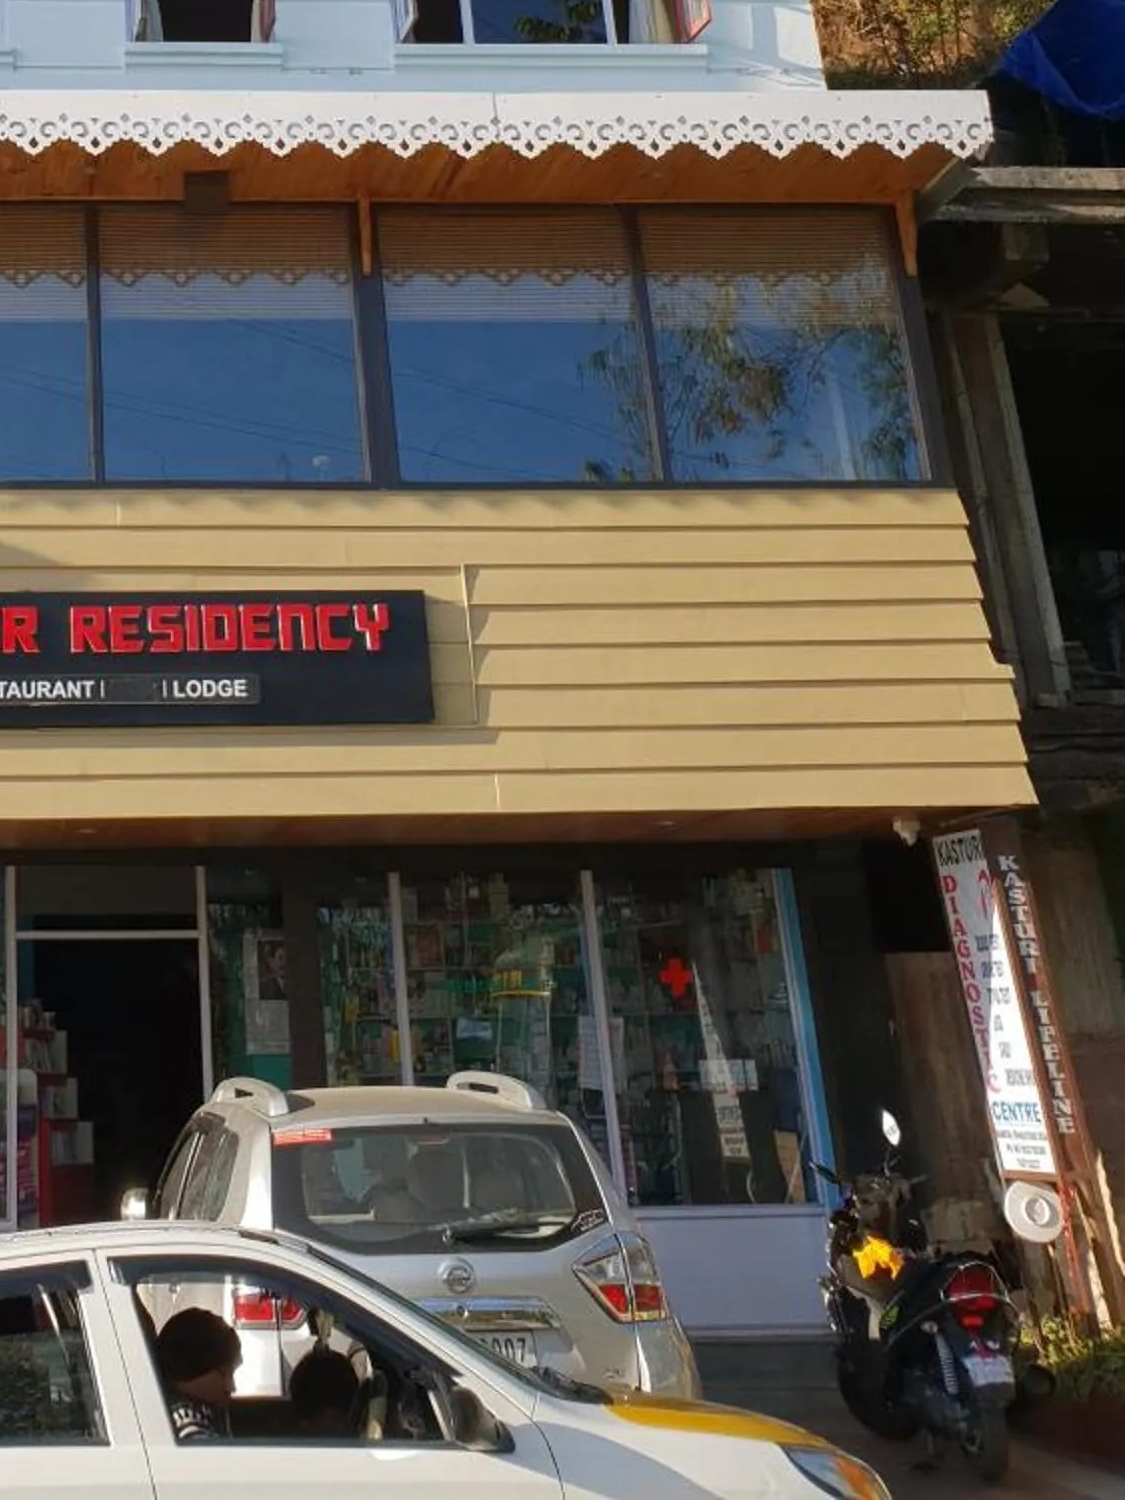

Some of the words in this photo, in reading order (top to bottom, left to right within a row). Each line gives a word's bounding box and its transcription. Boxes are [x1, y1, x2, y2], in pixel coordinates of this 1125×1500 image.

[70, 603, 390, 653] RESIDENCY
[173, 680, 248, 698] LODGE
[941, 875, 1001, 1093] DIAGNOSTIC
[997, 855, 1040, 975] KASTURI
[1031, 990, 1076, 1134] LIFELINE
[992, 1100, 1042, 1123] CENTRE
